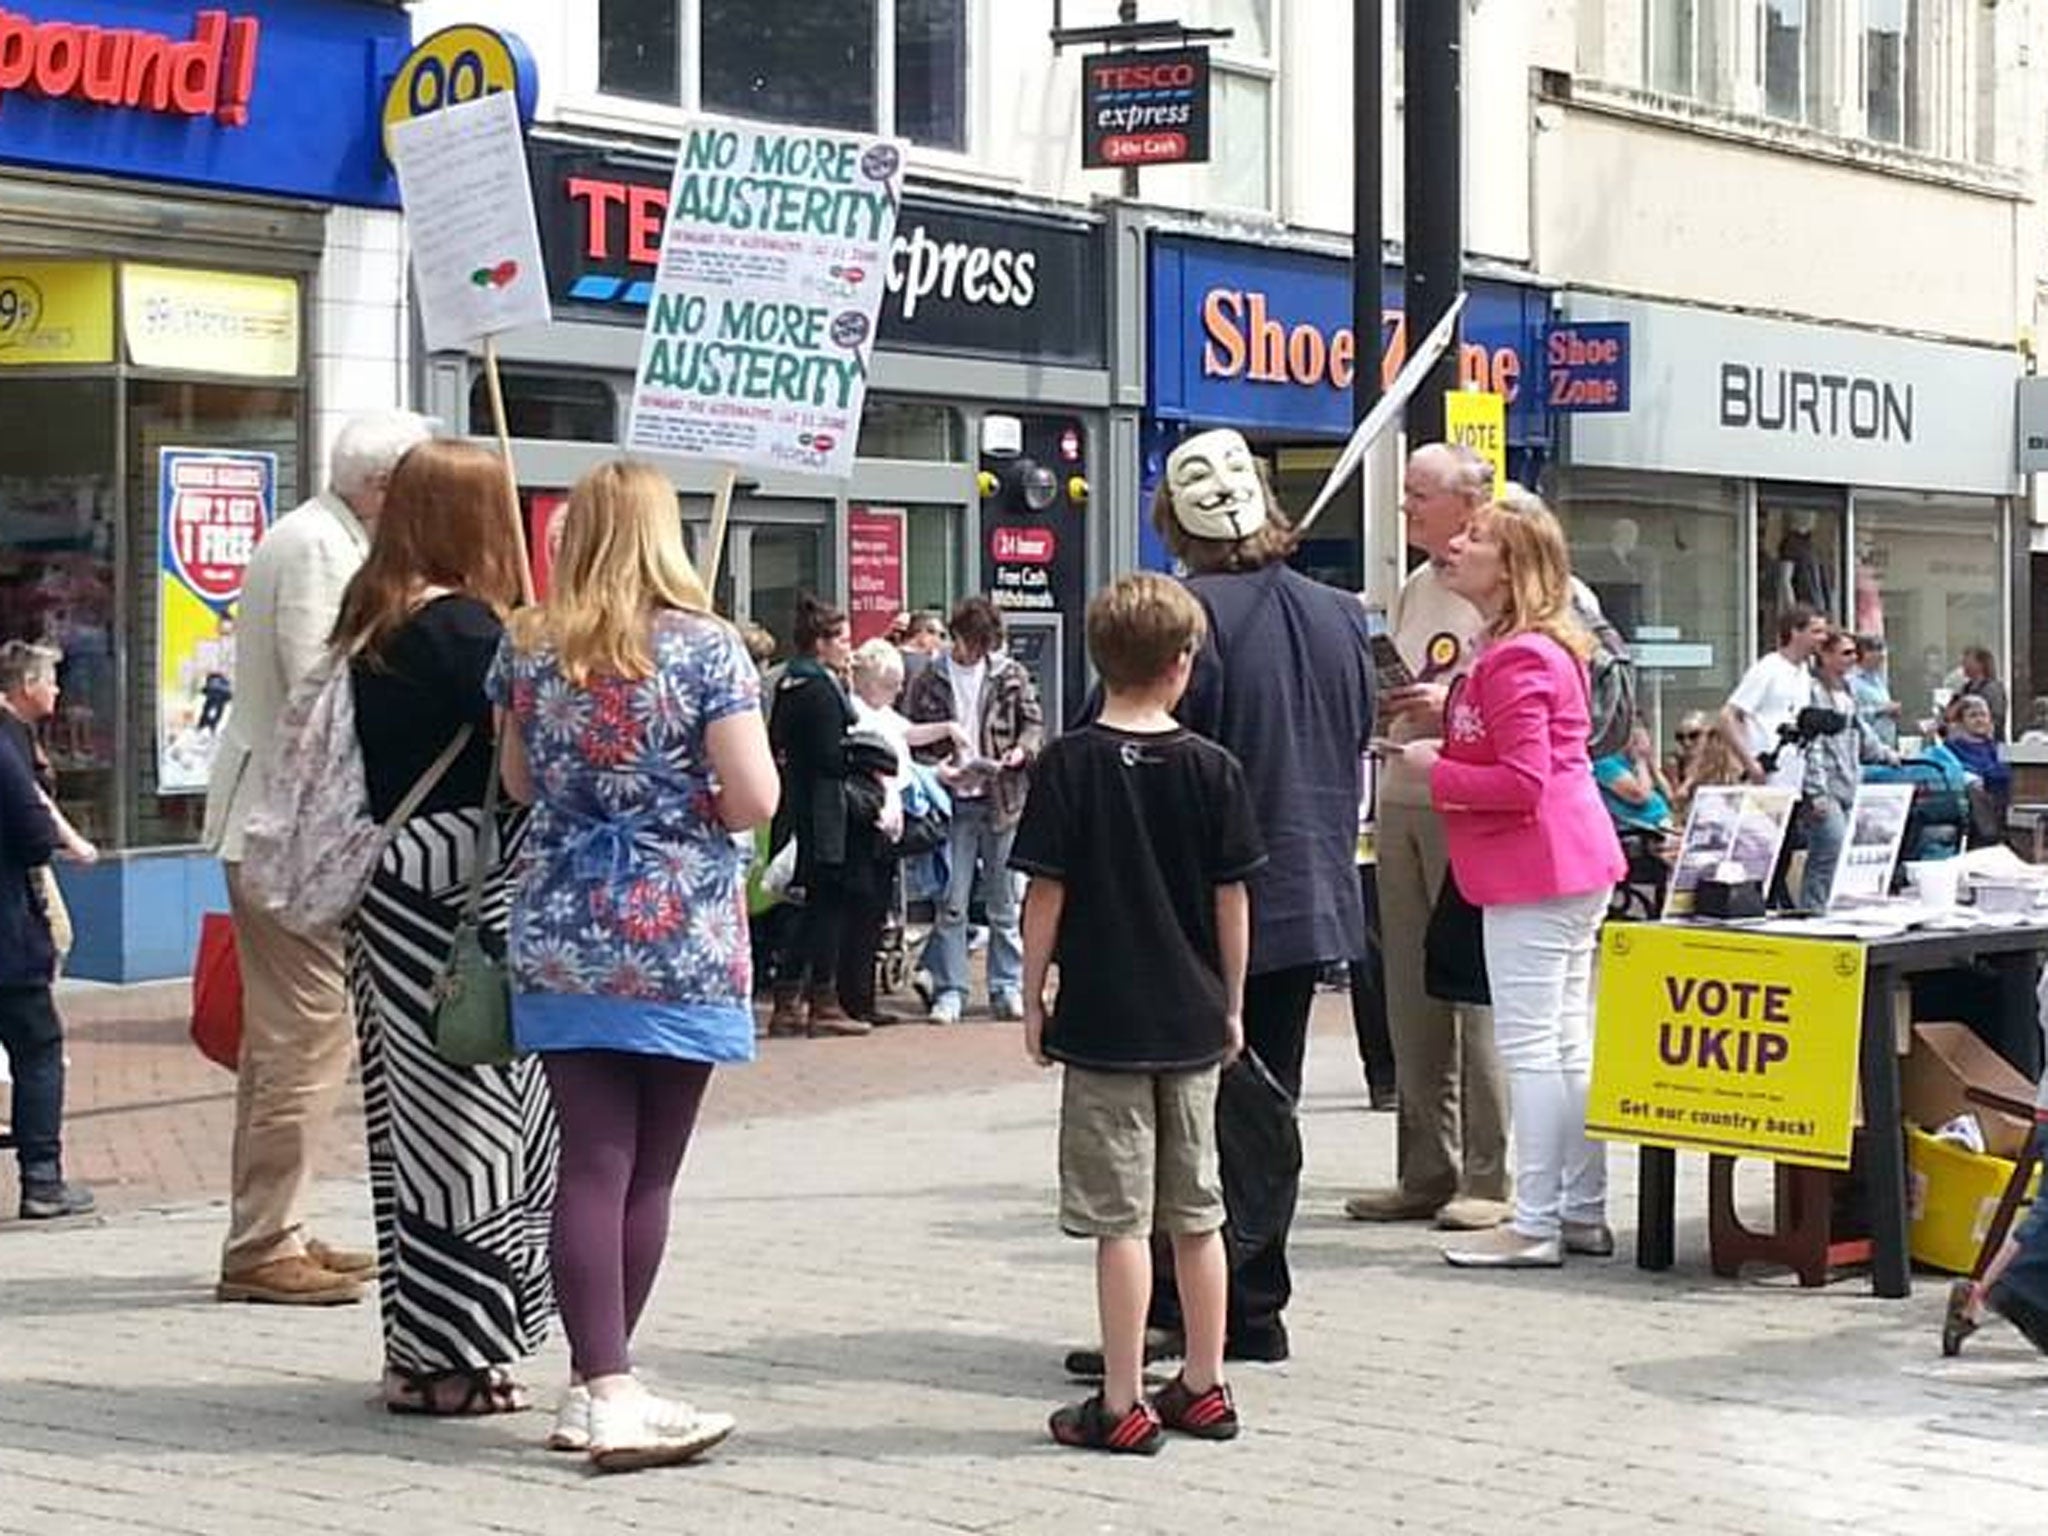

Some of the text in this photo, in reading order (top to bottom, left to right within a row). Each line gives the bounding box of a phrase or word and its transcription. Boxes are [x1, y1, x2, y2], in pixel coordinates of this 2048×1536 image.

[1094, 64, 1194, 90] TESCO
[1098, 104, 1191, 133] express
[683, 129, 739, 170] NO
[751, 135, 860, 184] MORE
[675, 173, 890, 242] AUSTERITY
[652, 293, 707, 335] NO
[718, 300, 829, 350] MORE
[1203, 288, 1354, 389] Shoe
[1547, 330, 1619, 367] Shoe
[643, 338, 862, 410] AUSTERITY
[1547, 370, 1619, 406] Zone
[1720, 363, 1914, 443] BURTON
[1453, 422, 1498, 450] VOTE
[180, 495, 213, 523] BUY
[228, 497, 257, 524] GET
[199, 524, 254, 566] FREE
[1017, 533, 1047, 555] hour
[997, 565, 1049, 586] Free Cash
[1665, 976, 1792, 1024] VOTE
[1659, 1022, 1790, 1076] UKIP
[1619, 1098, 1816, 1138] Get our country back!
